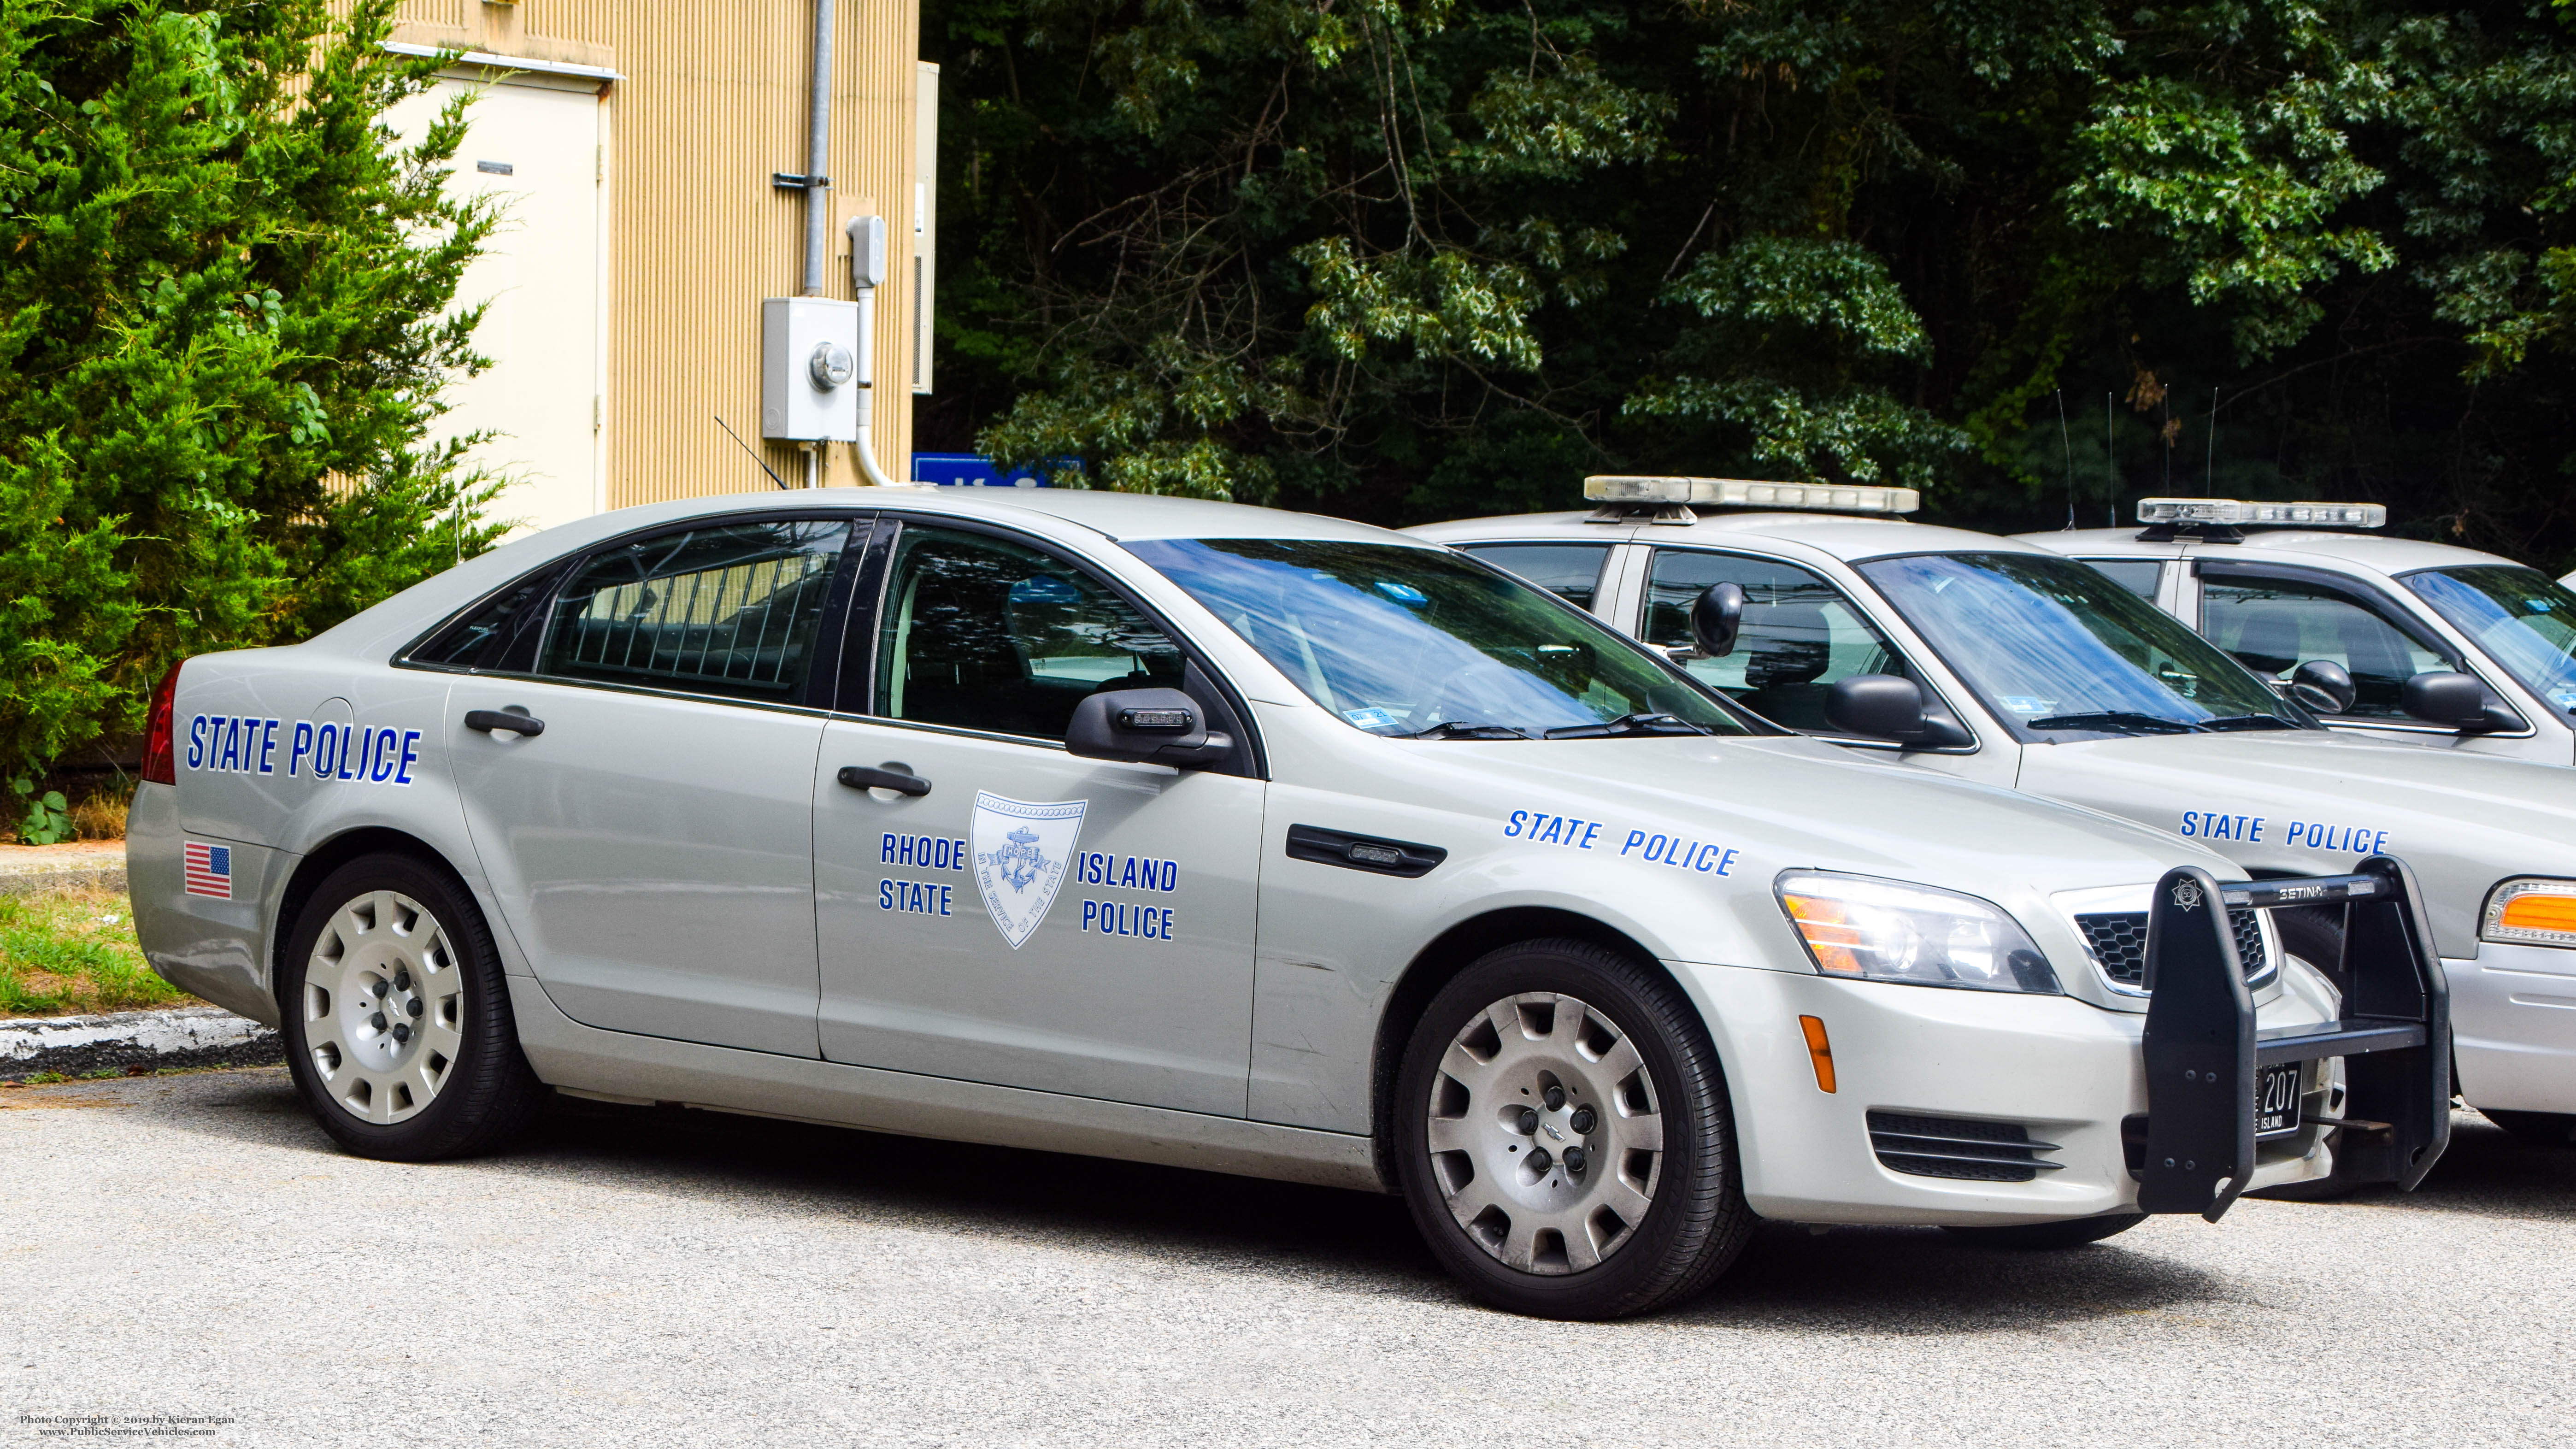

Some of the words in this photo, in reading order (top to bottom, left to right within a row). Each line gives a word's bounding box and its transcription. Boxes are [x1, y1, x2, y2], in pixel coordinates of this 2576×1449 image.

[187, 713, 280, 776] STATE
[288, 719, 423, 788] POLICE
[1503, 809, 1604, 851] STATE
[1618, 828, 1741, 879] POLICE
[2180, 809, 2266, 843] STATE
[2284, 820, 2390, 855] POLICE
[880, 832, 966, 872] RHODE
[978, 852, 987, 865] IN
[1007, 847, 1033, 857] HOPE
[981, 867, 993, 890] THE
[1043, 861, 1062, 896] STATE
[1076, 851, 1179, 893] ISLAND
[878, 878, 952, 917] STATE
[988, 891, 1014, 932] SERVICE
[1029, 896, 1045, 917] THE
[2280, 886, 2323, 900] SETINA
[1017, 918, 1029, 933] OF
[1082, 899, 1174, 942] POLICE
[2264, 1070, 2297, 1113] 207
[2261, 1115, 2282, 1129] ISLAND
